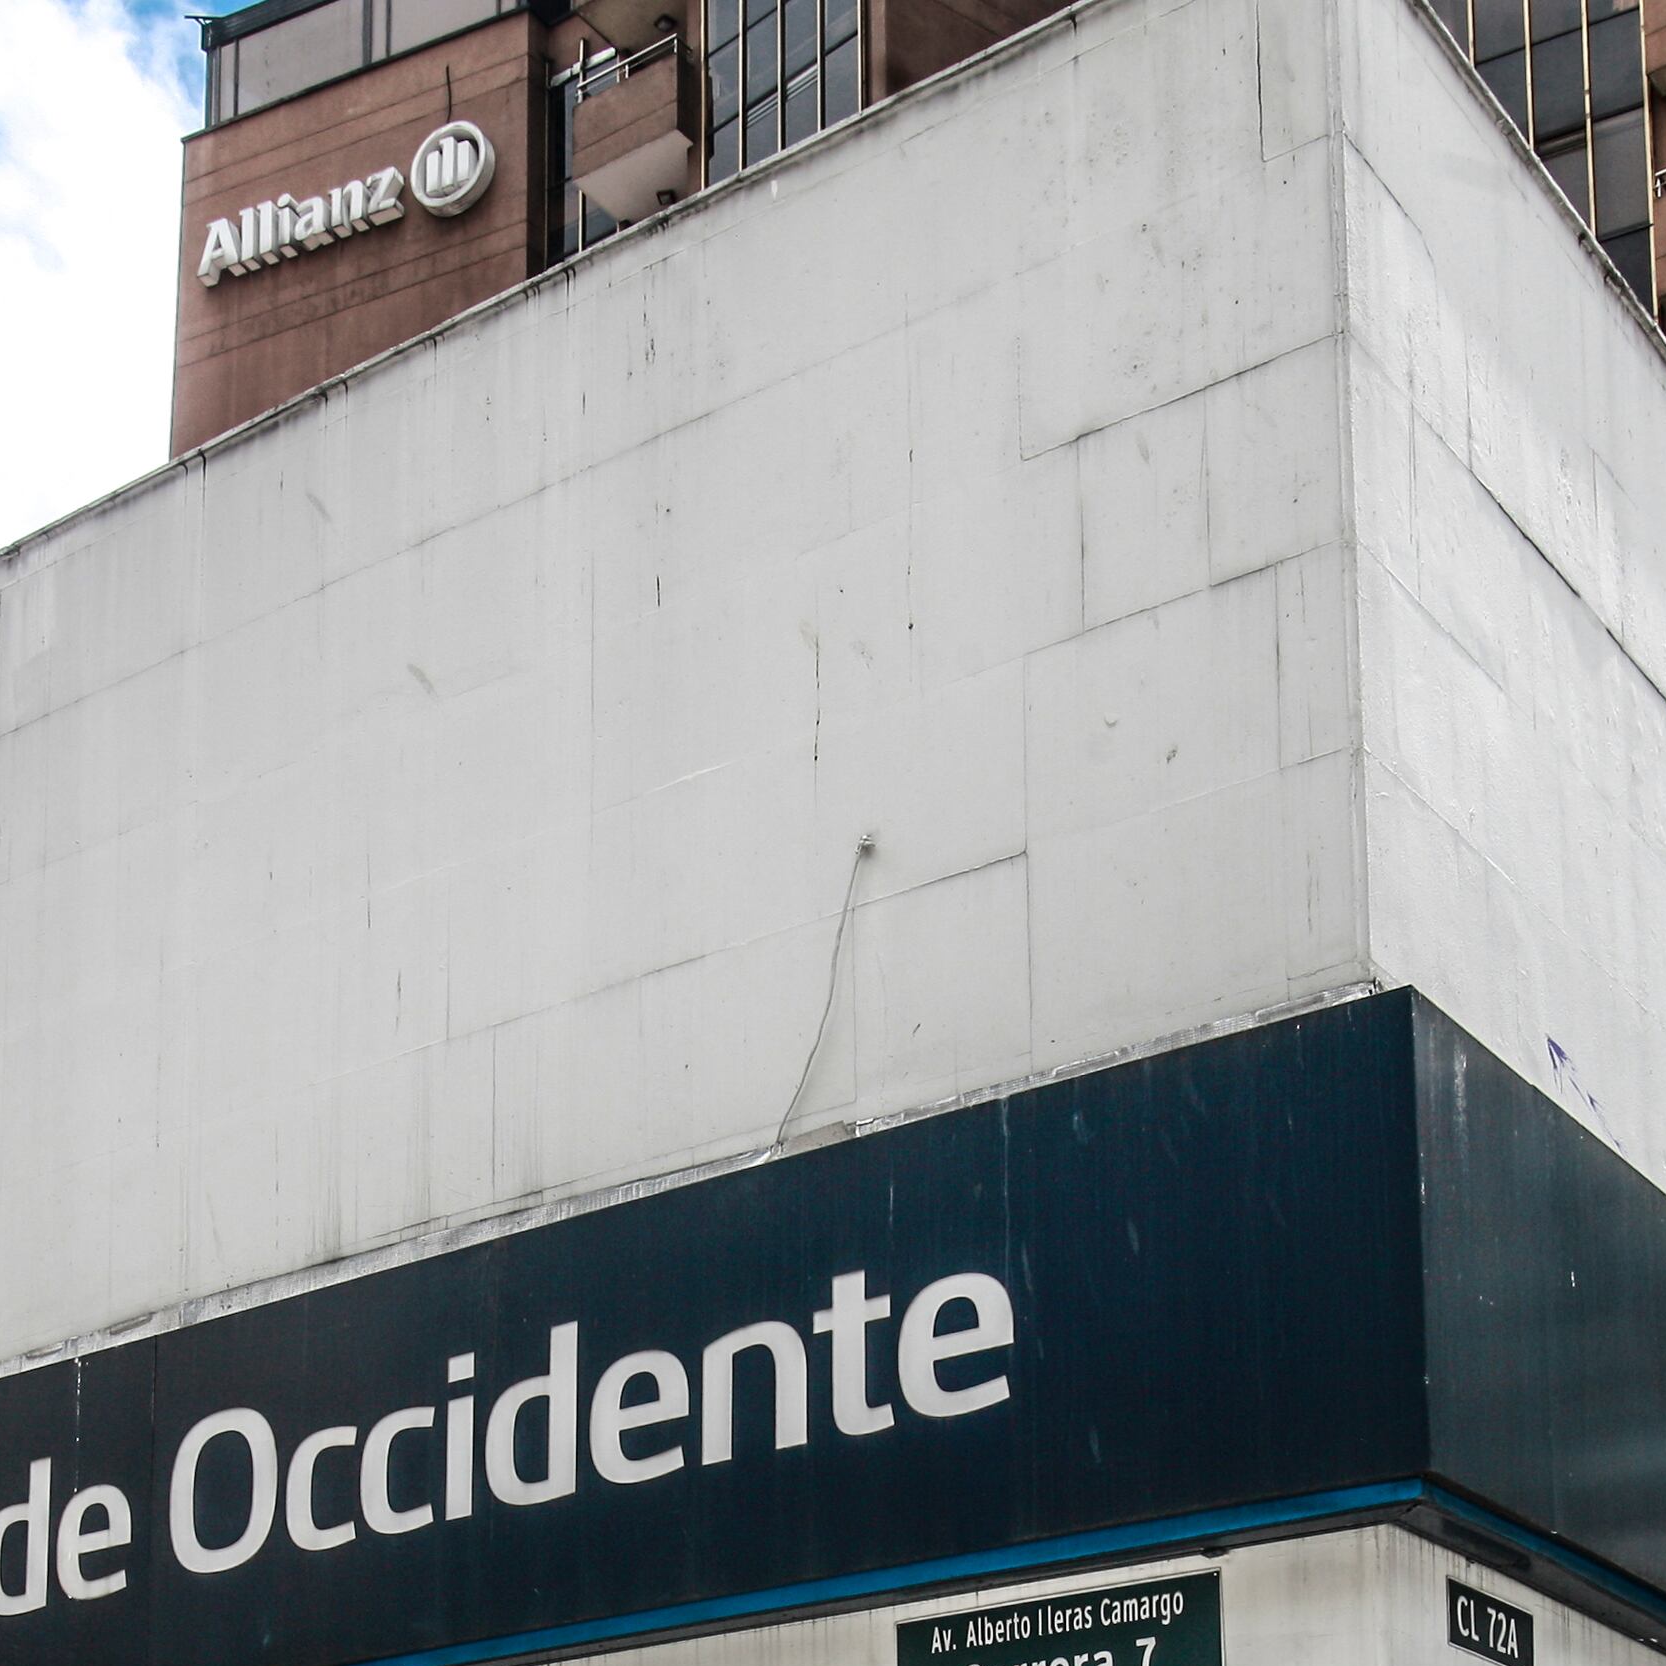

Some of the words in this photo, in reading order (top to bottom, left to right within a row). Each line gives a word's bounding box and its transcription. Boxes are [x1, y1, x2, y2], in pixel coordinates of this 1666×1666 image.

[197, 166, 405, 287] Allianz
[168, 1269, 1015, 1575] Occidente
[931, 1626, 957, 1654] Av.
[966, 1612, 1031, 1648] Alberto
[1100, 1591, 1184, 1626] Camargo
[1457, 1595, 1480, 1642] CL
[1486, 1606, 1519, 1659] 72A
